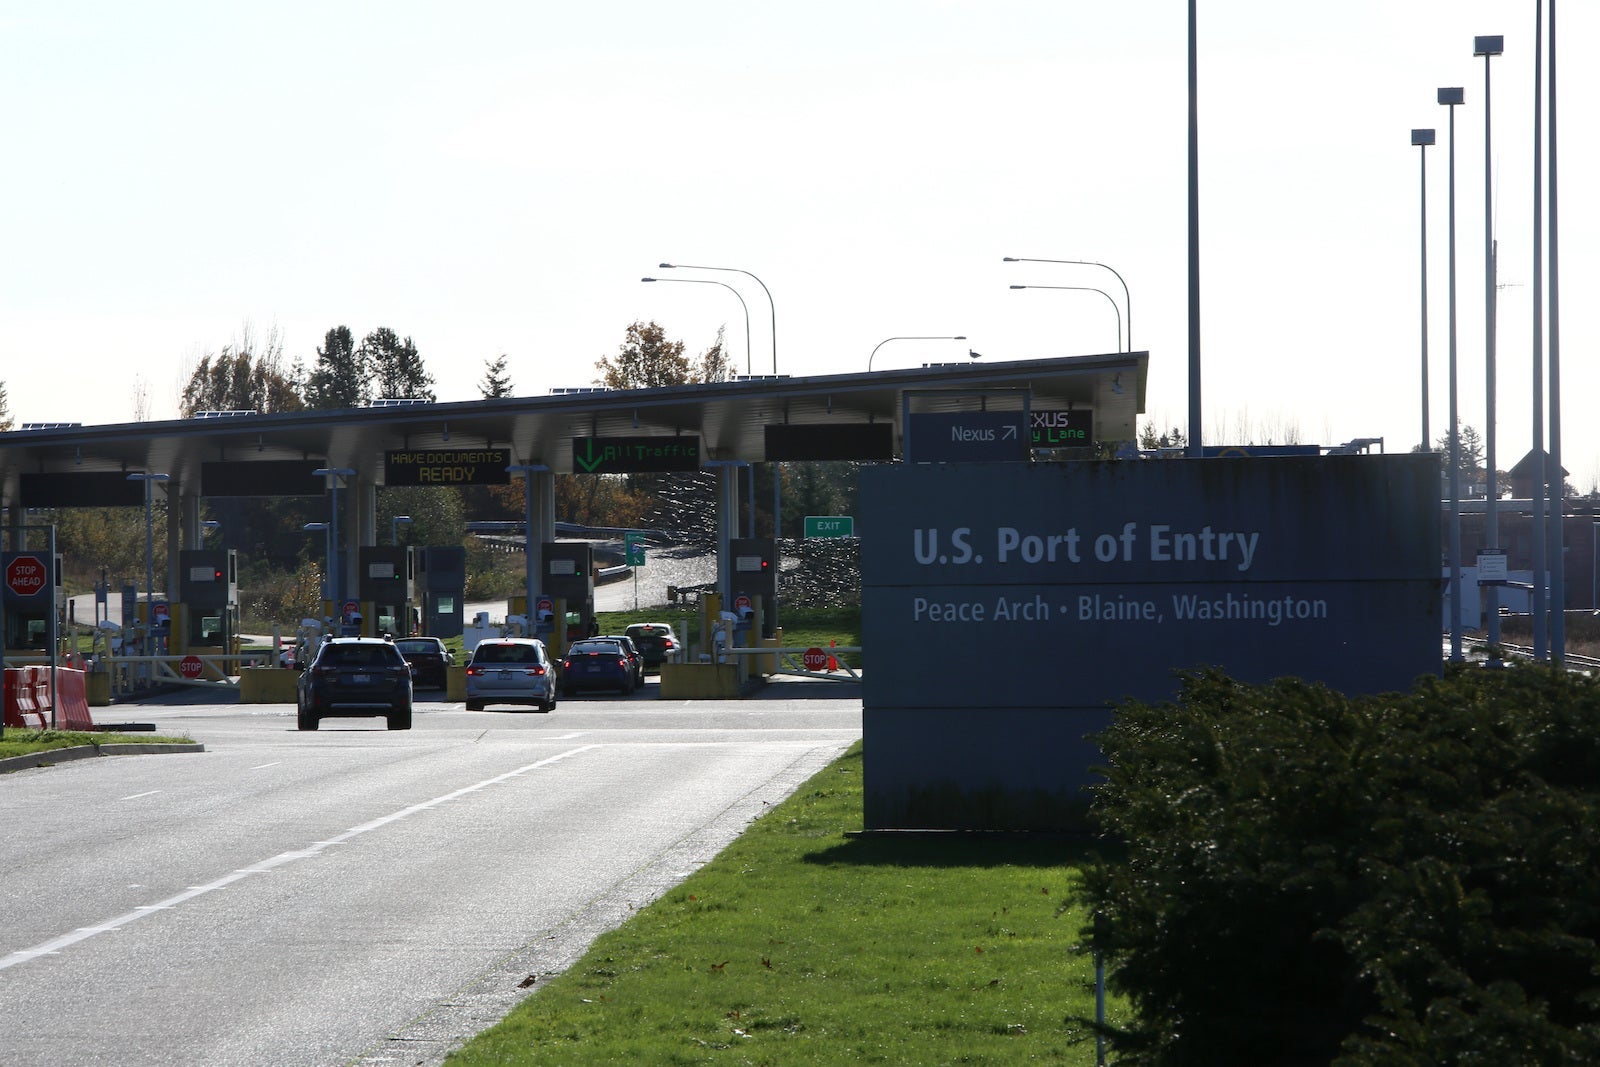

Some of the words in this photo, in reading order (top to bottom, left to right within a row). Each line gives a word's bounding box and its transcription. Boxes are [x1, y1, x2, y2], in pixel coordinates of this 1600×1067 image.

[951, 425, 996, 441] Nexus
[1047, 428, 1085, 443] Lane
[391, 453, 426, 464] HAVE
[427, 452, 503, 464] DOCUMENTS
[604, 447, 632, 461] All
[638, 444, 697, 460] Traffic
[419, 467, 475, 482] READY
[816, 520, 842, 531] EXIT
[913, 528, 984, 565] U.S.
[998, 527, 1081, 563] Port
[1094, 522, 1137, 563] of
[1150, 525, 1260, 572] Entry
[15, 566, 37, 575] STOP
[12, 577, 41, 586] AHEAD
[913, 598, 985, 622] Peace
[993, 596, 1050, 621] Arch
[1078, 595, 1165, 624] Blaine,
[1172, 592, 1328, 626] Washington
[804, 655, 825, 665] STOP
[181, 662, 201, 672] STOP
